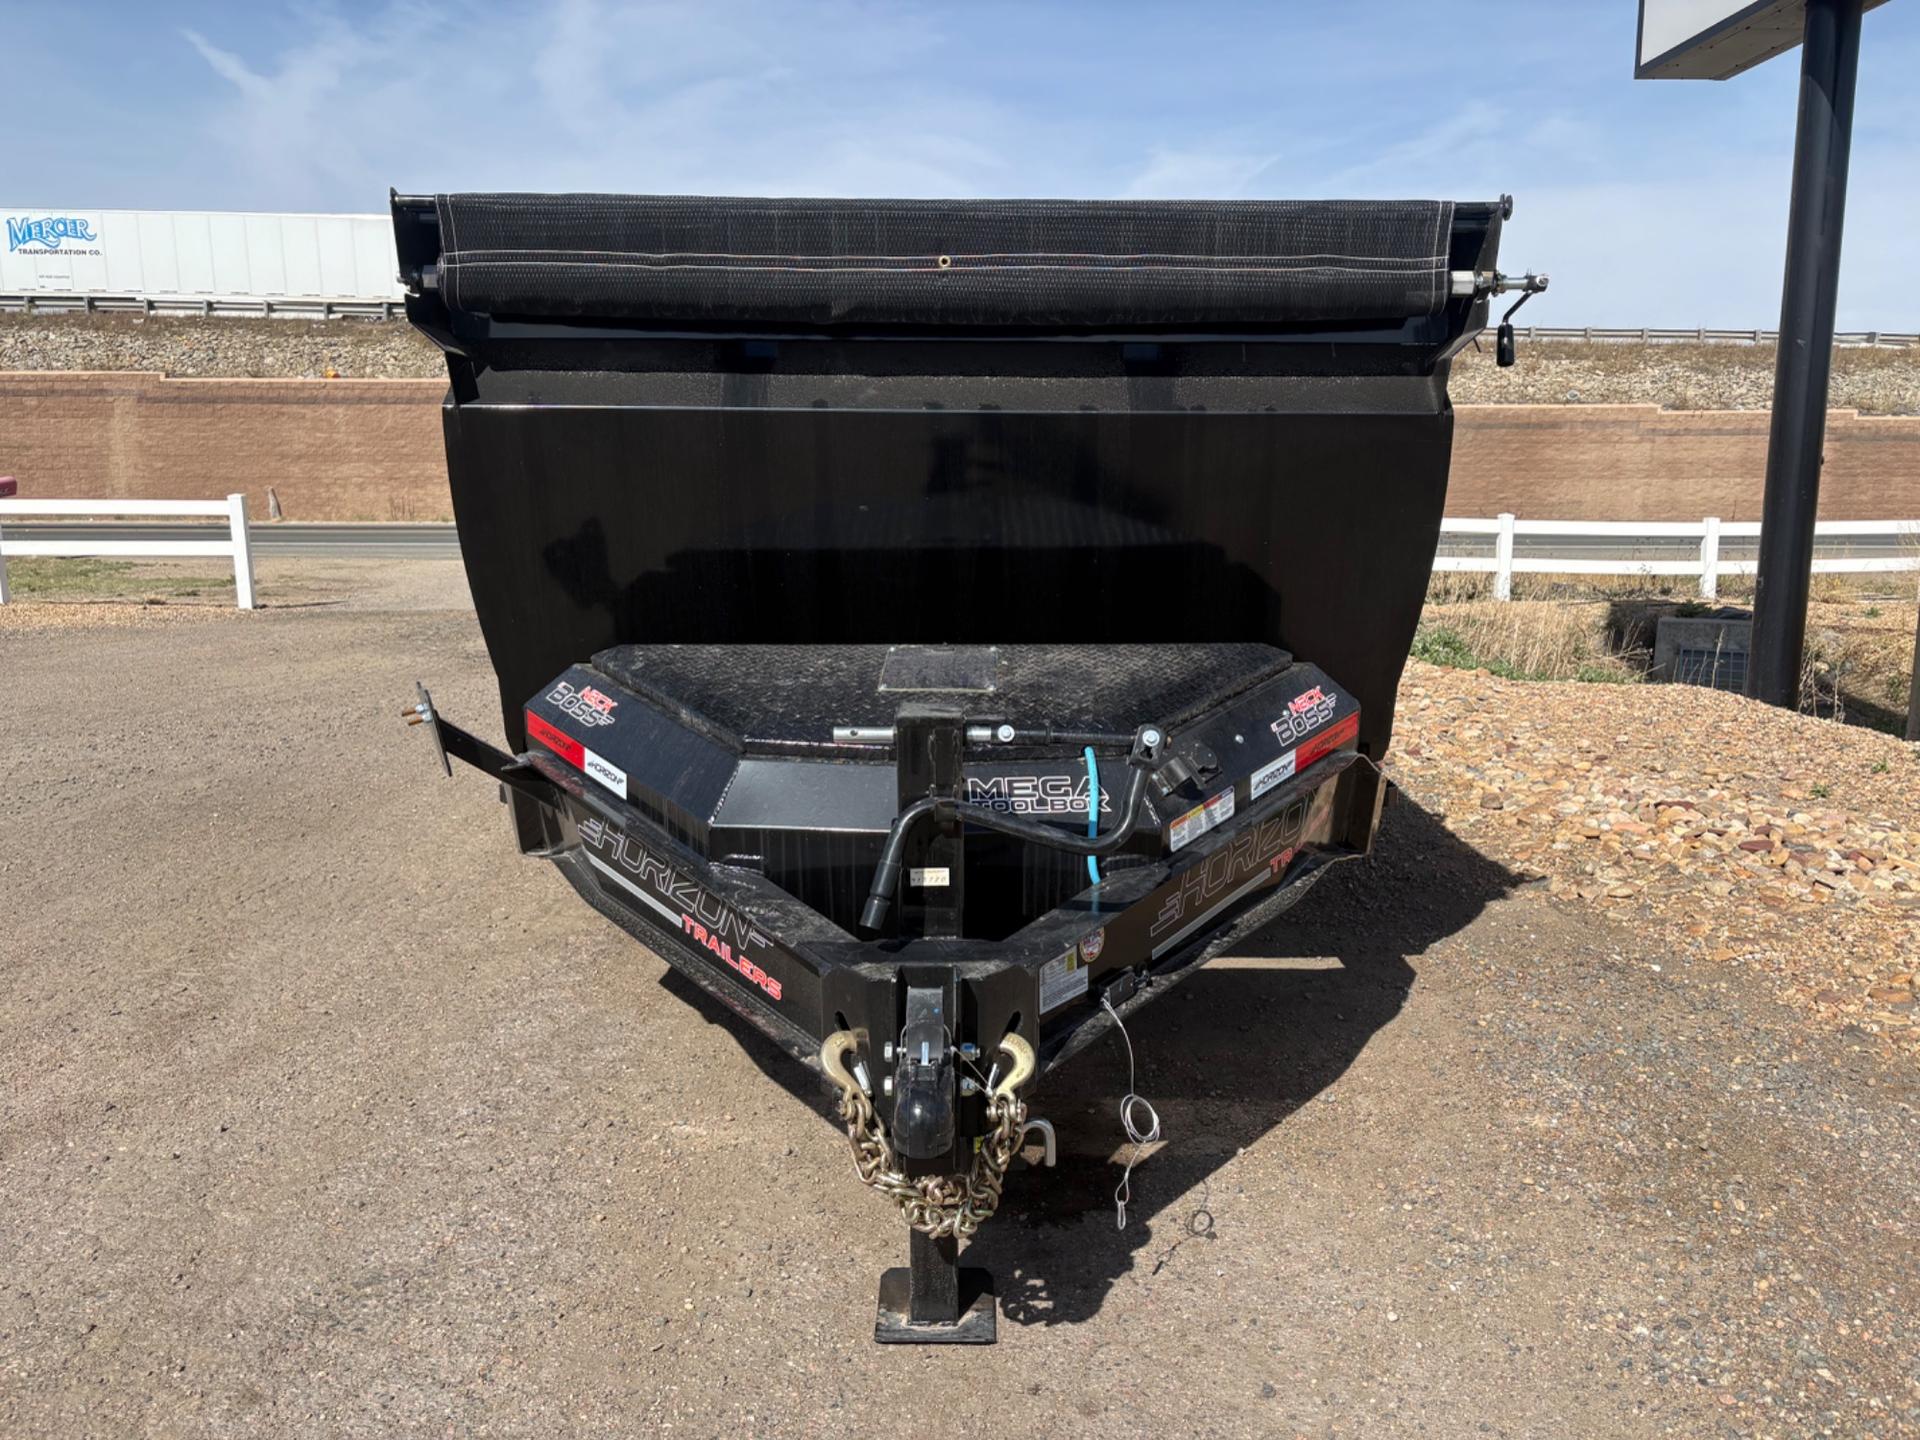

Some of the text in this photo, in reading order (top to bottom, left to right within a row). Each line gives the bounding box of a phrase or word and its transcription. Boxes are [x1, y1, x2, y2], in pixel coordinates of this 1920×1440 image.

[6, 217, 97, 252] MERCER
[546, 681, 610, 727] BOSS
[1270, 695, 1335, 747] BOSS
[1288, 685, 1326, 716] NECK
[968, 775, 1109, 800] MEGA
[578, 818, 774, 950] HORIZON
[682, 913, 783, 1000] TRAILERS
